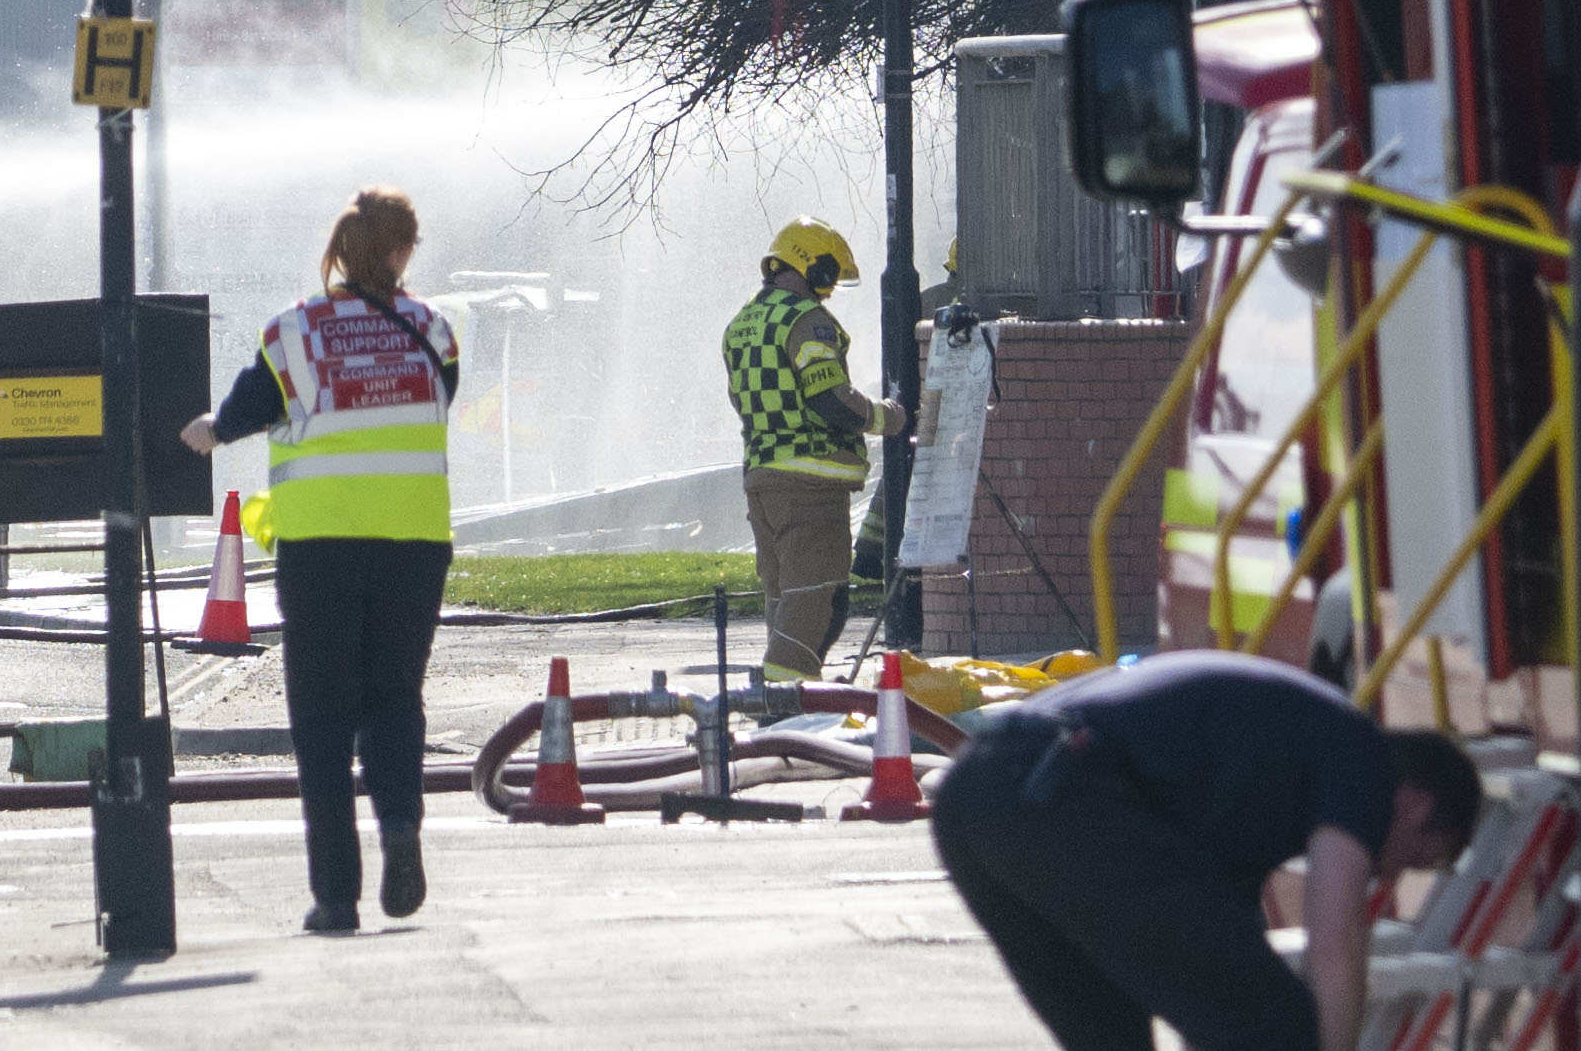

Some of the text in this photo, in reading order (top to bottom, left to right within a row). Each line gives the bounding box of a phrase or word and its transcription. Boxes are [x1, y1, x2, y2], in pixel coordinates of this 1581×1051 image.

[84, 26, 144, 99] H
[330, 332, 411, 353] SUPPORT
[340, 363, 419, 381] COMMAND
[12, 387, 61, 399] Chevron
[363, 378, 398, 394] UNIT
[351, 390, 413, 409] LEADER
